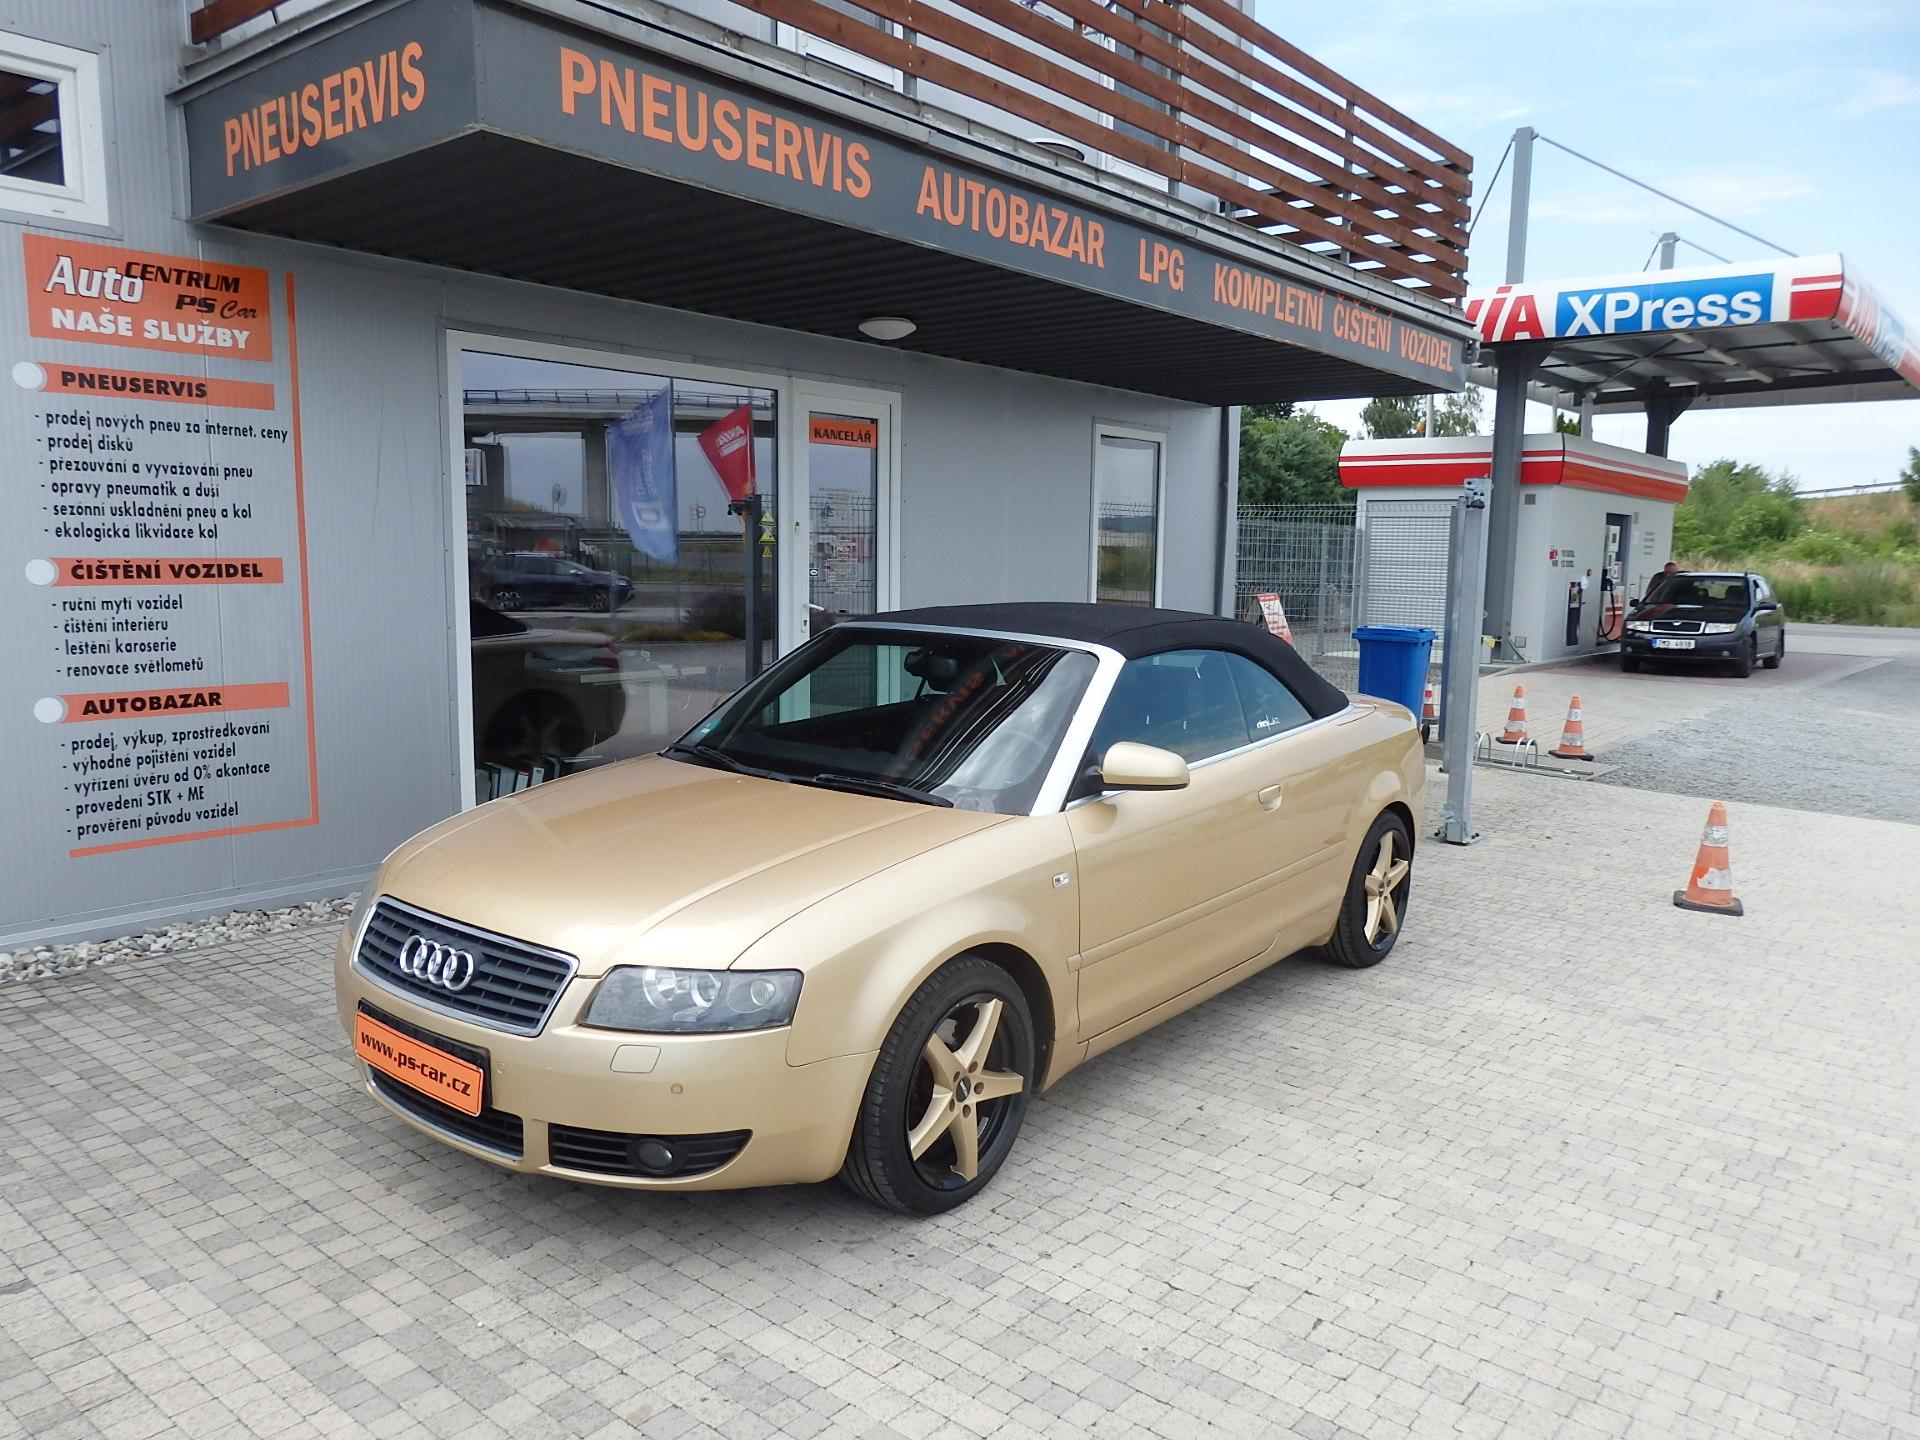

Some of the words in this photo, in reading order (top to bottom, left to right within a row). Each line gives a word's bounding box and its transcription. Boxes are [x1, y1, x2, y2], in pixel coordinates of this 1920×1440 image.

[224, 41, 425, 177] PNEUSERVIS
[560, 46, 872, 199] PNEUSERVIS
[916, 165, 1105, 268] AUTOBAZAR
[1138, 238, 1185, 292] LPG
[1214, 262, 1327, 332] KOMPLETNÍ
[1333, 292, 1394, 353] ČIŠTĚNÍ
[1400, 326, 1454, 373] VOZIDEL
[44, 254, 144, 304] Auto
[125, 261, 241, 294] CENTRUM
[175, 294, 217, 314] PS
[220, 300, 259, 320] Car
[1564, 289, 1763, 337] XPress
[51, 306, 133, 337] NAŠE
[143, 318, 250, 349] SLUŽBY
[61, 371, 208, 399] PNEUSERVIS
[46, 410, 91, 430] prodej
[96, 414, 144, 432] nových
[149, 419, 180, 435] pneu
[186, 421, 200, 434] za
[260, 427, 288, 443] ceny
[814, 427, 872, 444] KANCELÁŘ
[48, 434, 93, 453] prodej
[98, 435, 133, 452] disků
[50, 457, 127, 475] přezouvání
[132, 462, 140, 474] a
[146, 461, 219, 478] vyvažování
[224, 465, 253, 480] pneu
[51, 481, 100, 498] opravy
[107, 481, 177, 498] pneumatik
[183, 486, 190, 497] a
[195, 482, 219, 498] duší
[53, 501, 105, 517] sezónní
[110, 501, 182, 518] uskladnění
[187, 505, 216, 521] pneu
[221, 507, 228, 519] a
[233, 503, 252, 519] kol
[55, 522, 130, 542] ekologická
[136, 523, 194, 539] likvidace
[200, 523, 217, 539] kol
[71, 559, 161, 580] ČIŠTĚNÍ
[169, 563, 262, 580] VOZIDEL
[62, 597, 96, 612] ruční
[137, 593, 183, 610] vozidel
[64, 618, 107, 633] čištění
[112, 615, 168, 632] interiéru
[65, 639, 110, 655] leštění
[115, 637, 177, 653] karoserie
[67, 662, 129, 677] renovace
[134, 656, 204, 673] světlometů
[82, 691, 222, 716] AUTOBAZAR
[123, 729, 167, 749] výkup,
[172, 721, 270, 745] zprostředkování
[73, 752, 131, 775] výhodné
[136, 750, 189, 769] pojištění
[193, 742, 236, 760] vozidel
[74, 775, 129, 796] vyřízení
[134, 772, 170, 787] úvěru
[174, 768, 189, 782] od
[193, 764, 212, 780] 0%
[216, 762, 270, 778] akontace
[76, 795, 143, 818] provedení
[147, 790, 172, 806] STK
[188, 786, 205, 802] ME
[146, 808, 191, 830] původu
[195, 801, 239, 821] vozidel
[361, 1030, 471, 1097] www.ps-car.cz
